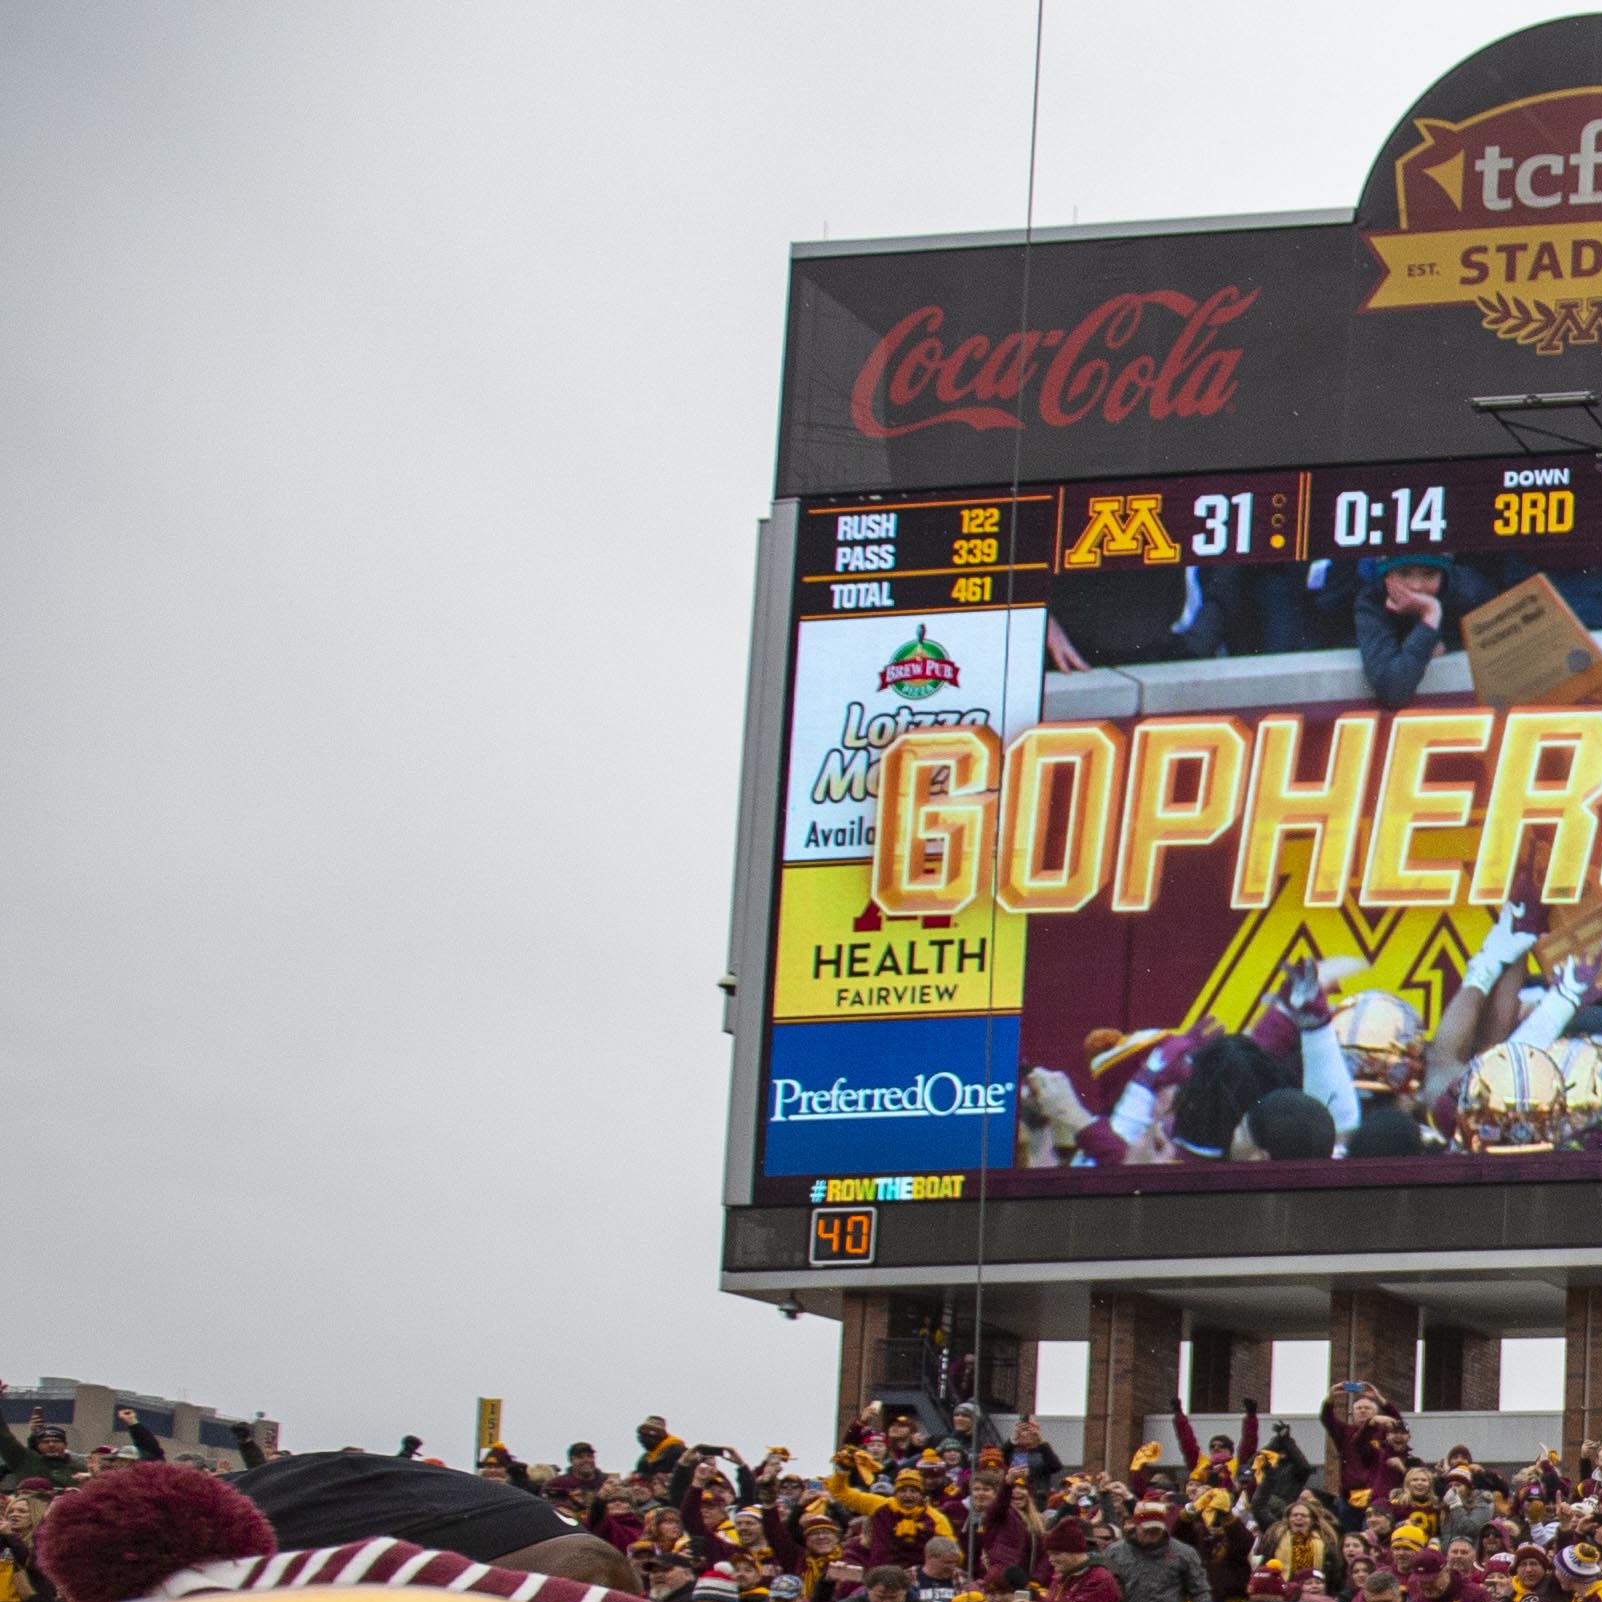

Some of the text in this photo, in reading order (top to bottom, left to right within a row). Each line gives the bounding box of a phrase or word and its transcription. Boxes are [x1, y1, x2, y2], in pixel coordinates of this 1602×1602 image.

[1406, 262, 1440, 278] EST.
[850, 285, 1262, 438] Coca-Cola
[1503, 467, 1570, 488] DOWN
[836, 507, 1001, 543] RUSH 122
[1192, 491, 1255, 557] 31
[1333, 486, 1448, 549] 0:14
[1493, 490, 1575, 536] 3RD
[834, 537, 999, 573] PASS 339
[830, 575, 994, 611] TOTAL 461
[886, 659, 954, 681] BREW PUB
[813, 937, 988, 979] HEALTH
[836, 983, 959, 1008] FAIRVIEW
[771, 1070, 1007, 1122] PreferredOne
[809, 1174, 966, 1204] #ROWTHEBOAT
[816, 1214, 871, 1255] 40
